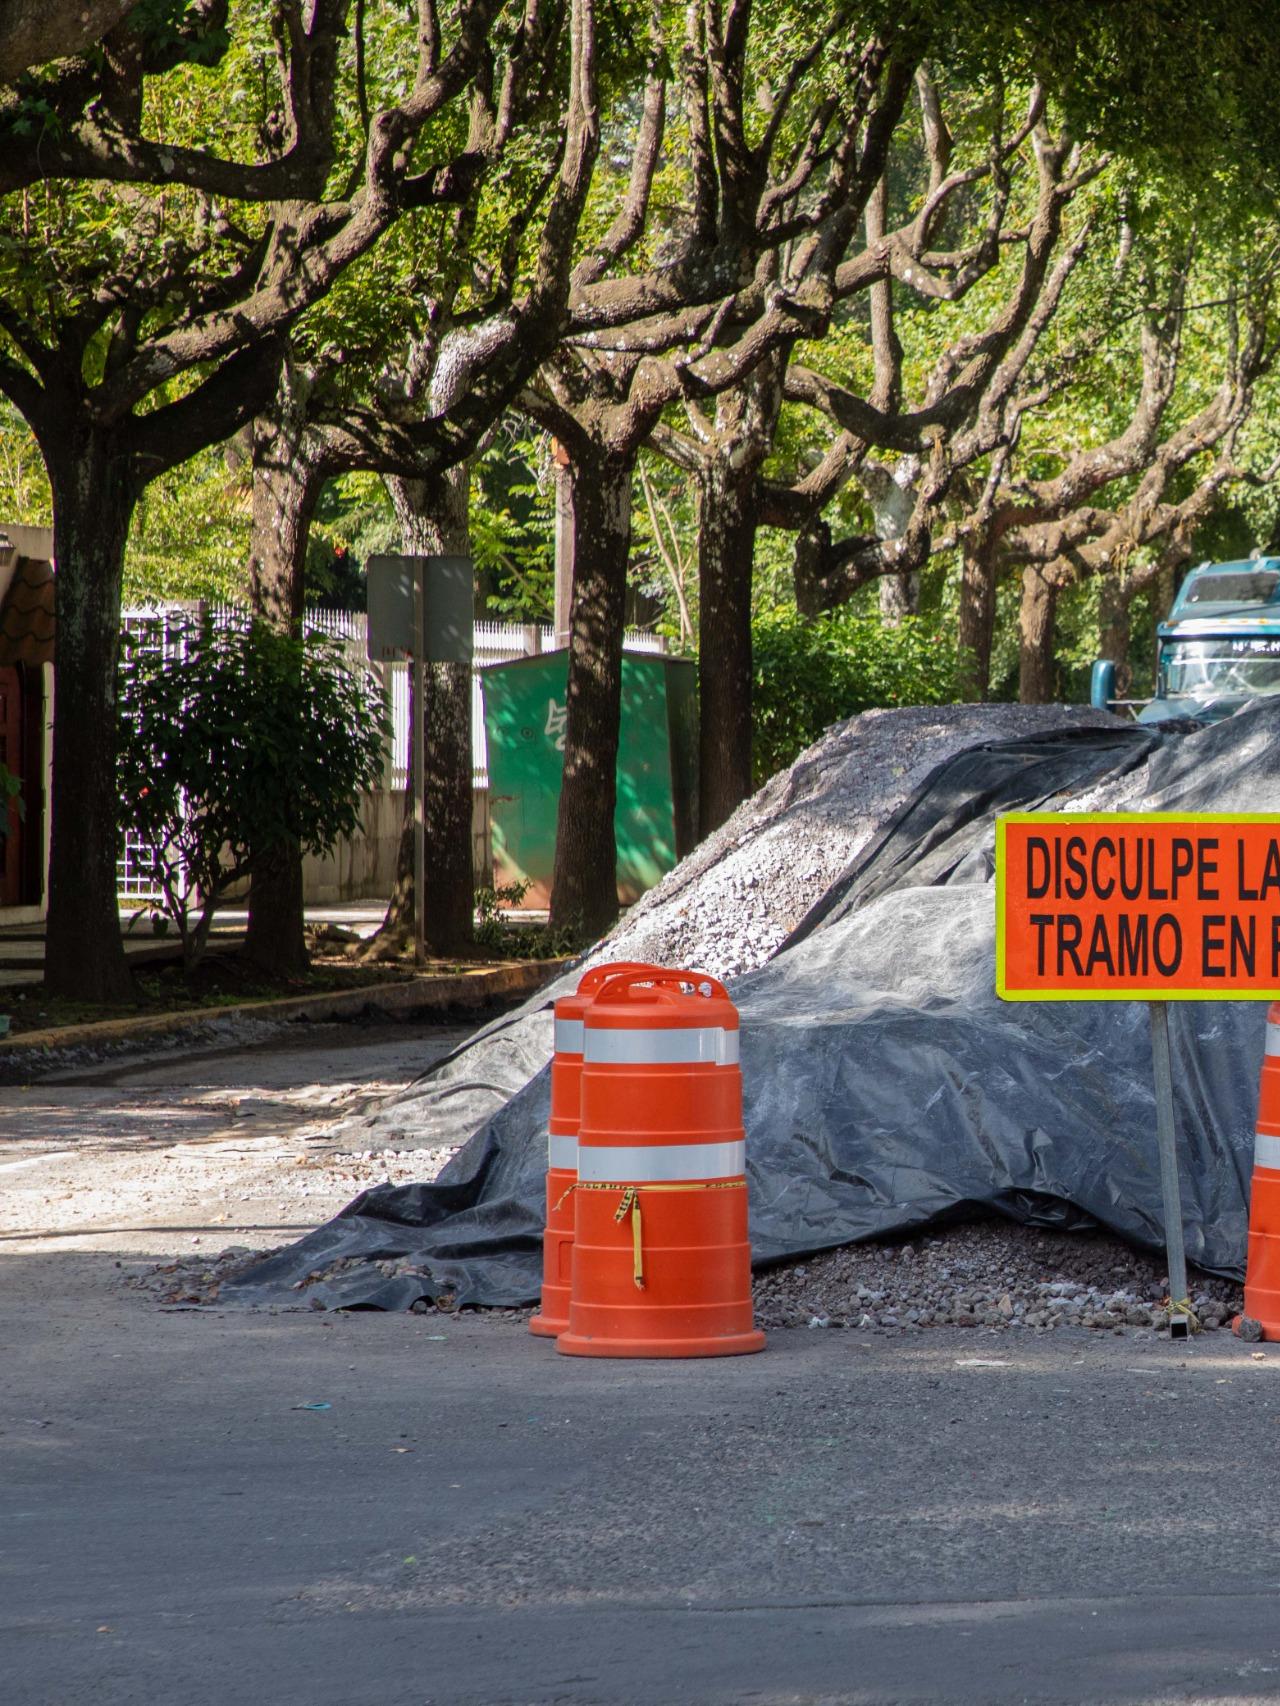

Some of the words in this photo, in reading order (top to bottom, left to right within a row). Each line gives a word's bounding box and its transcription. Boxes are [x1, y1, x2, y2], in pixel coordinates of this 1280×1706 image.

[1026, 836, 1220, 901] DISCULPE
[1029, 913, 1183, 977] TRAMO
[1201, 914, 1256, 978] EN
